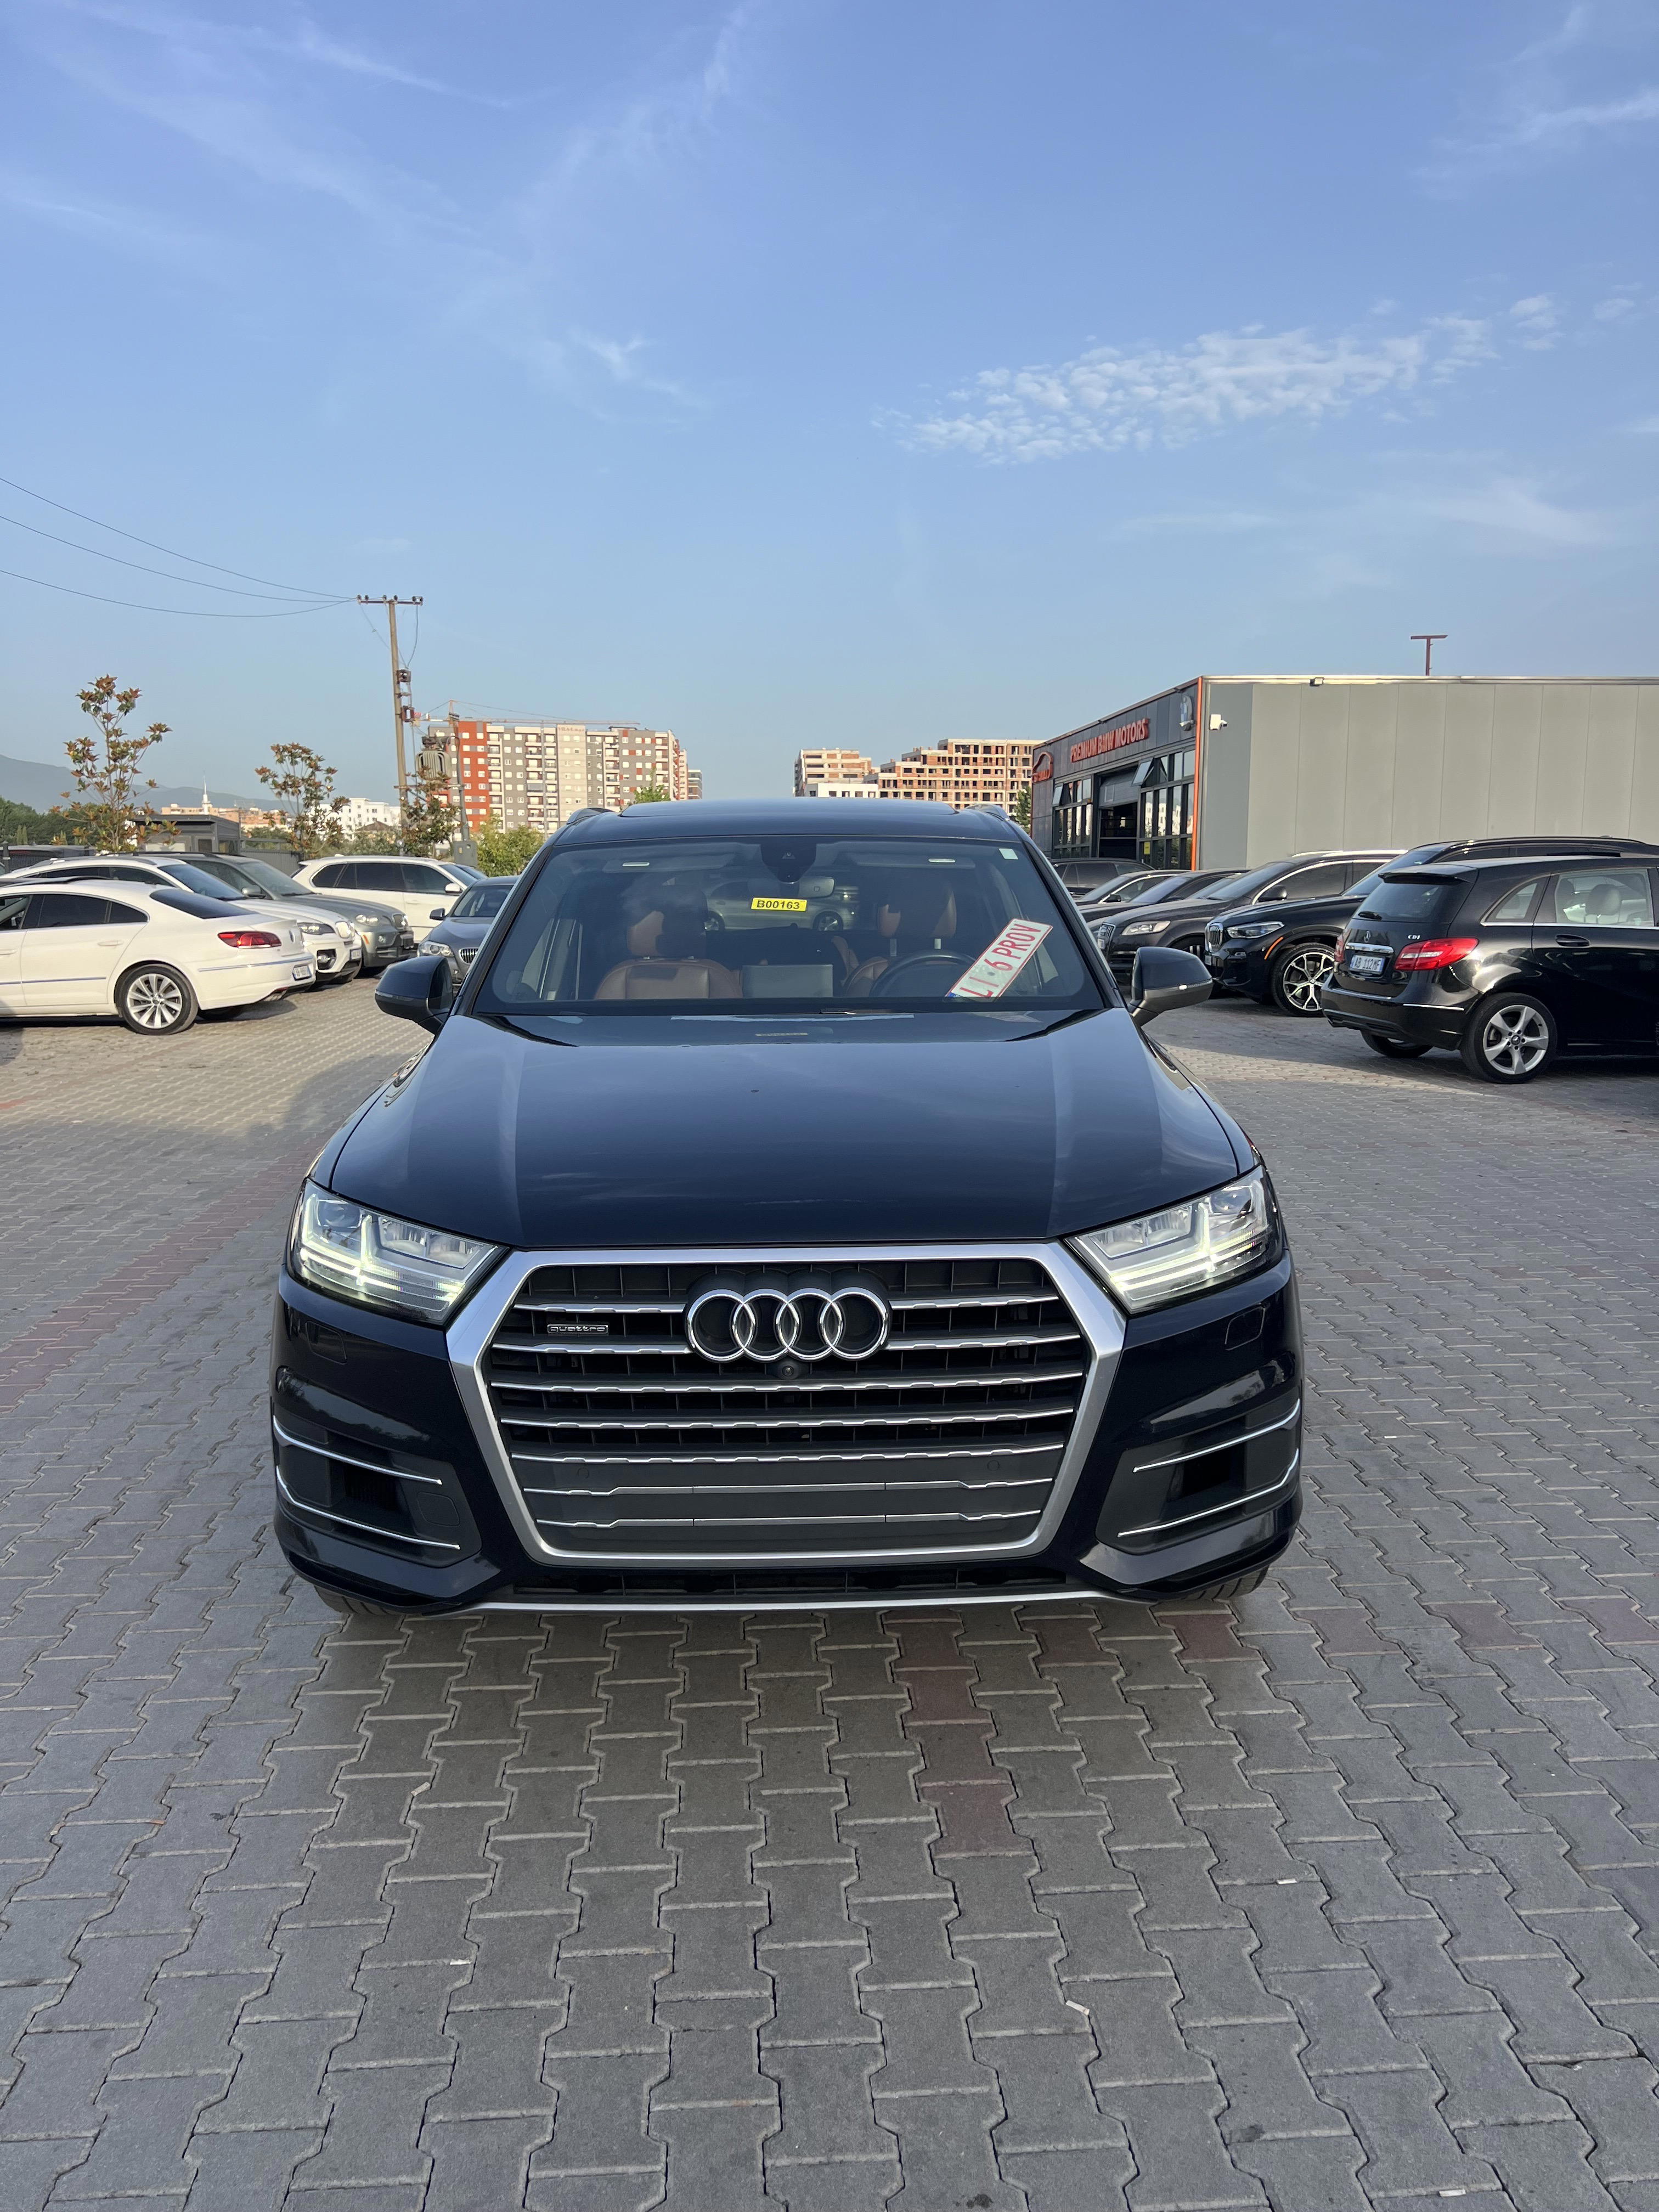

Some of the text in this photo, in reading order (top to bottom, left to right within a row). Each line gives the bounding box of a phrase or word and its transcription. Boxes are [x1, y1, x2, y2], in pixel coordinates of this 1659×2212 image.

[1071, 718, 1149, 763] PREMIUM BMW MOTORS
[757, 900, 800, 910] B00163
[991, 923, 1041, 960] PROV
[984, 958, 1013, 972] 6
